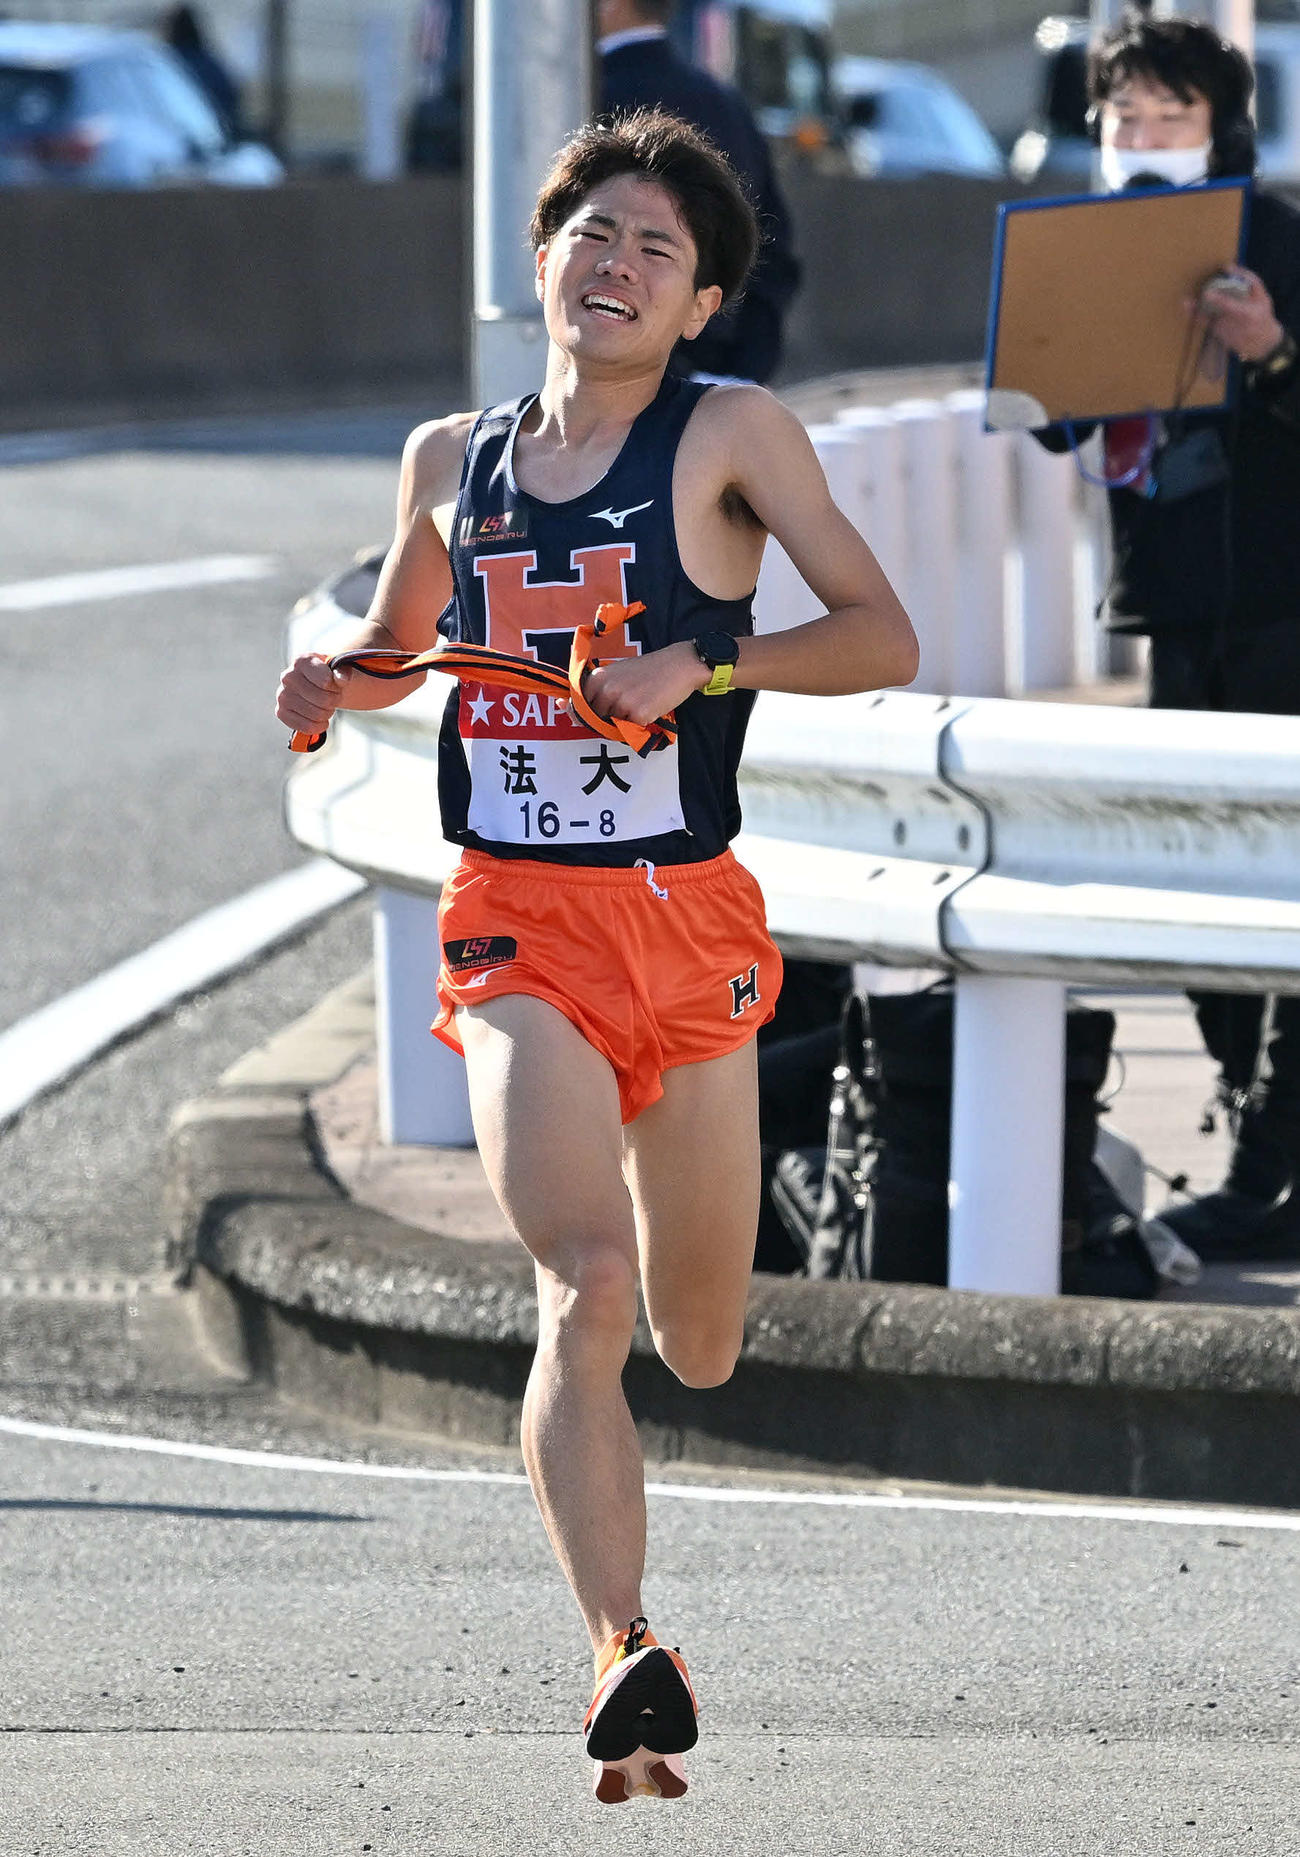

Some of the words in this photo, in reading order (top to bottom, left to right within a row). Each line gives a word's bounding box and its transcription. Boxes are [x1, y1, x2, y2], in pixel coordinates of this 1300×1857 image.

[473, 542, 642, 664] H
[502, 693, 584, 727] SAP
[520, 801, 616, 839] 16-8
[728, 962, 761, 1019] H
